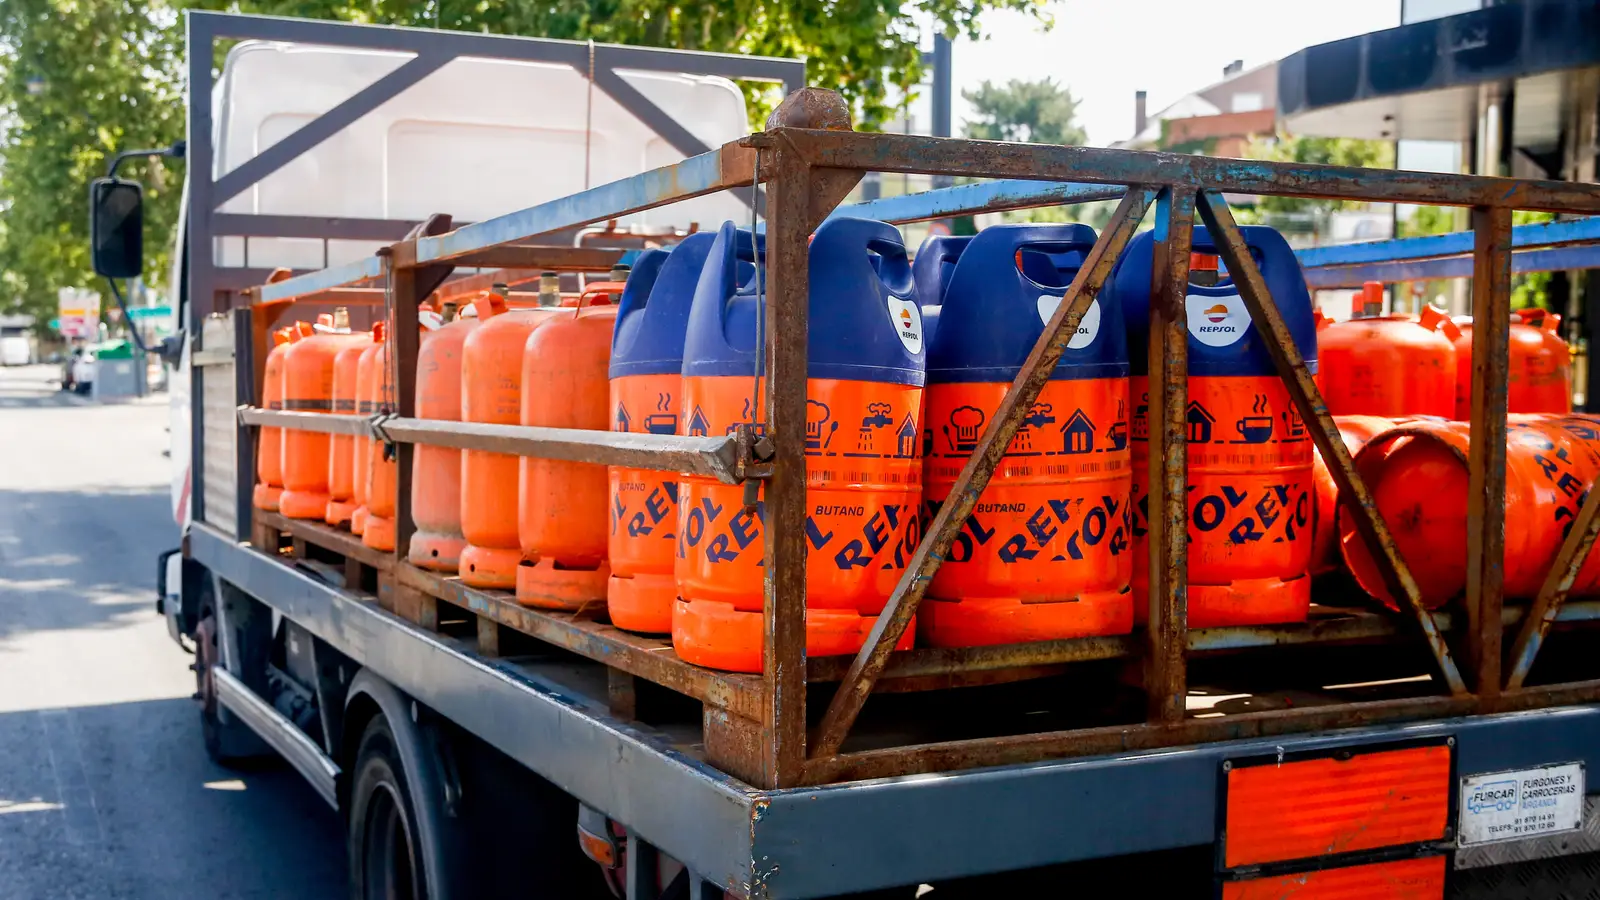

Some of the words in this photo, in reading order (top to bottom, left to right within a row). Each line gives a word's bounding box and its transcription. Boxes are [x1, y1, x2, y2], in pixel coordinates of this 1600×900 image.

[902, 331, 918, 341] REPSOL
[815, 505, 865, 517] BUTANO
[977, 503, 1026, 513] BUTANO
[1523, 776, 1565, 789] FURGONES
[1565, 775, 1572, 783] Y
[1473, 789, 1515, 802] FURCAR
[1522, 785, 1576, 800] CARROCERIAS
